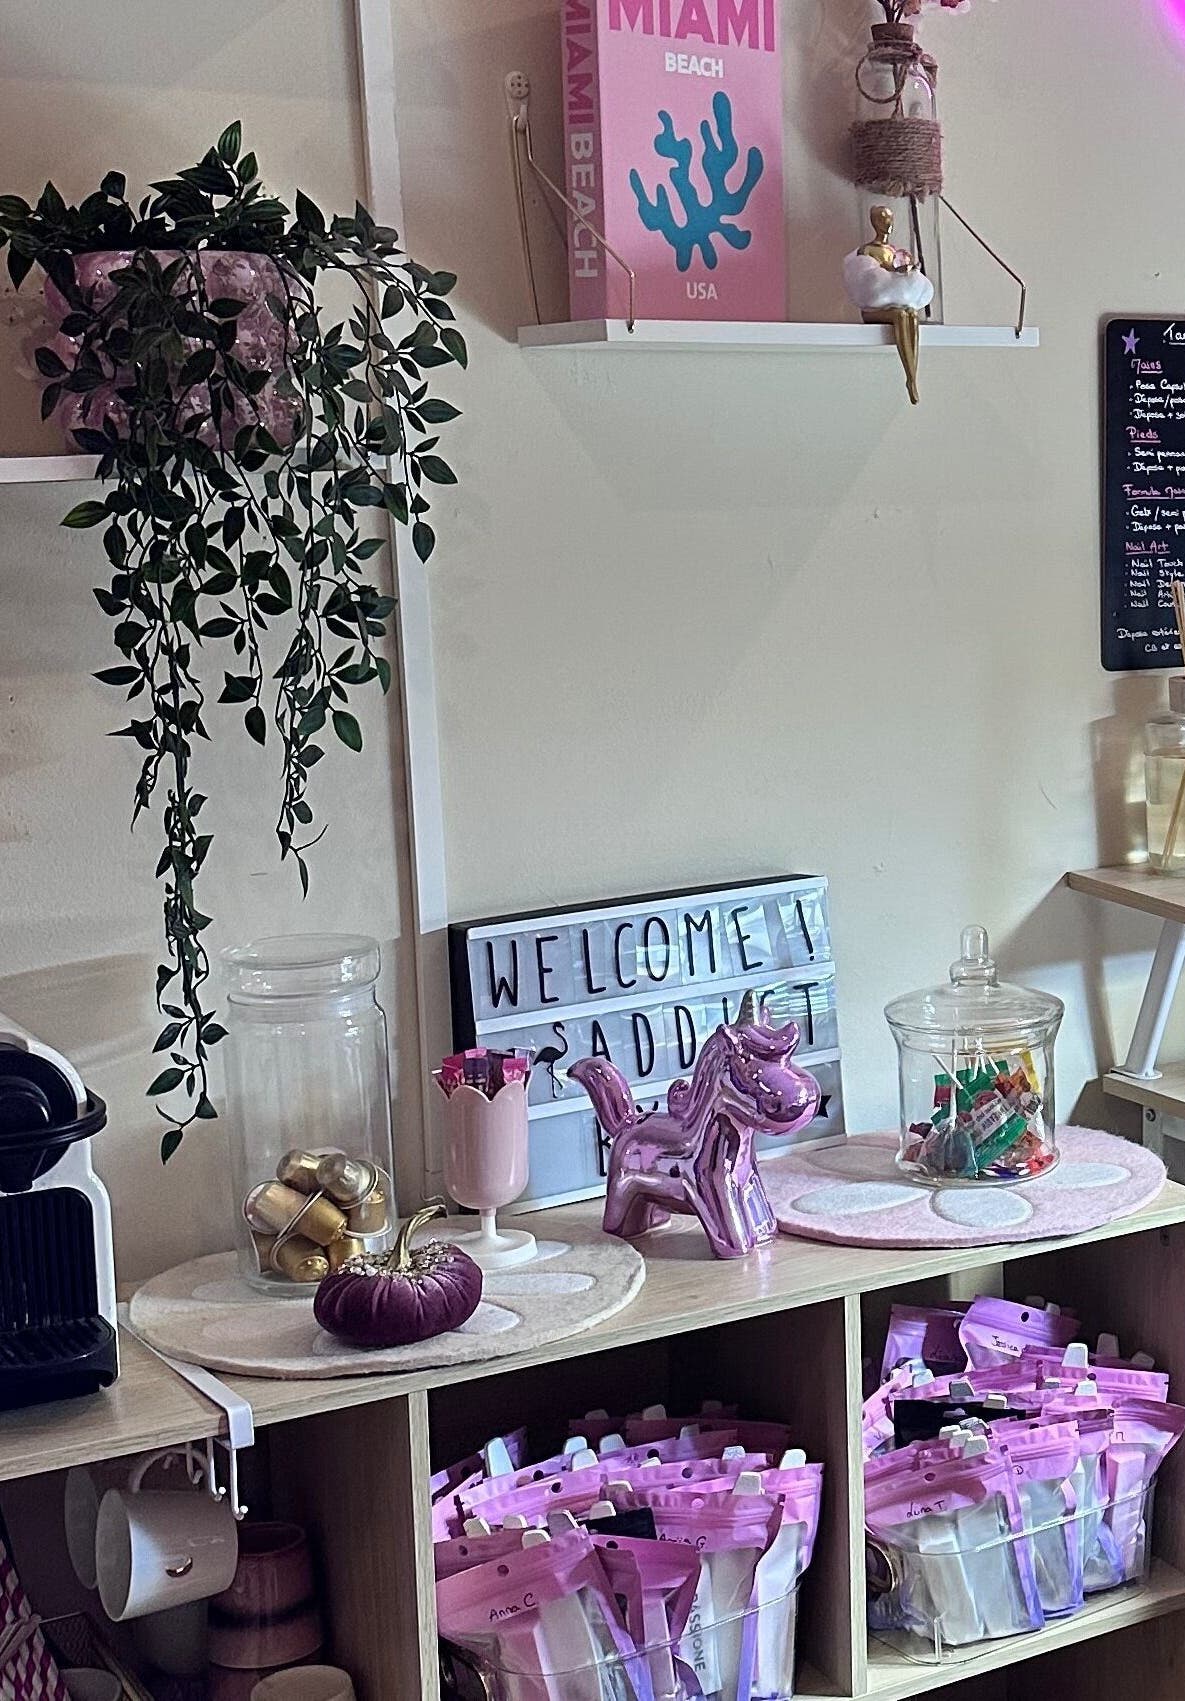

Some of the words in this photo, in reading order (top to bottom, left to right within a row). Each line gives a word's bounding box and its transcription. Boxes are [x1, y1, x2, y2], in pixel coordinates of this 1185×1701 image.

[608, 0, 775, 52] MIAMI
[664, 51, 724, 79] BEACH
[569, 132, 598, 278] BEACH
[685, 281, 719, 301] USA
[1125, 426, 1159, 439] Pieds
[1125, 541, 1146, 551] Nail
[1150, 540, 1169, 553] Art
[1131, 558, 1153, 568] Nail
[1130, 569, 1150, 577] Nail
[1129, 578, 1151, 588] Nail
[1129, 589, 1148, 597] Nail
[1130, 598, 1150, 608] Nail
[486, 905, 764, 1010] WELCOME
[795, 899, 816, 962] !
[591, 981, 819, 1079] ADDT
[489, 1608, 521, 1622] Anna
[523, 1592, 537, 1608] C
